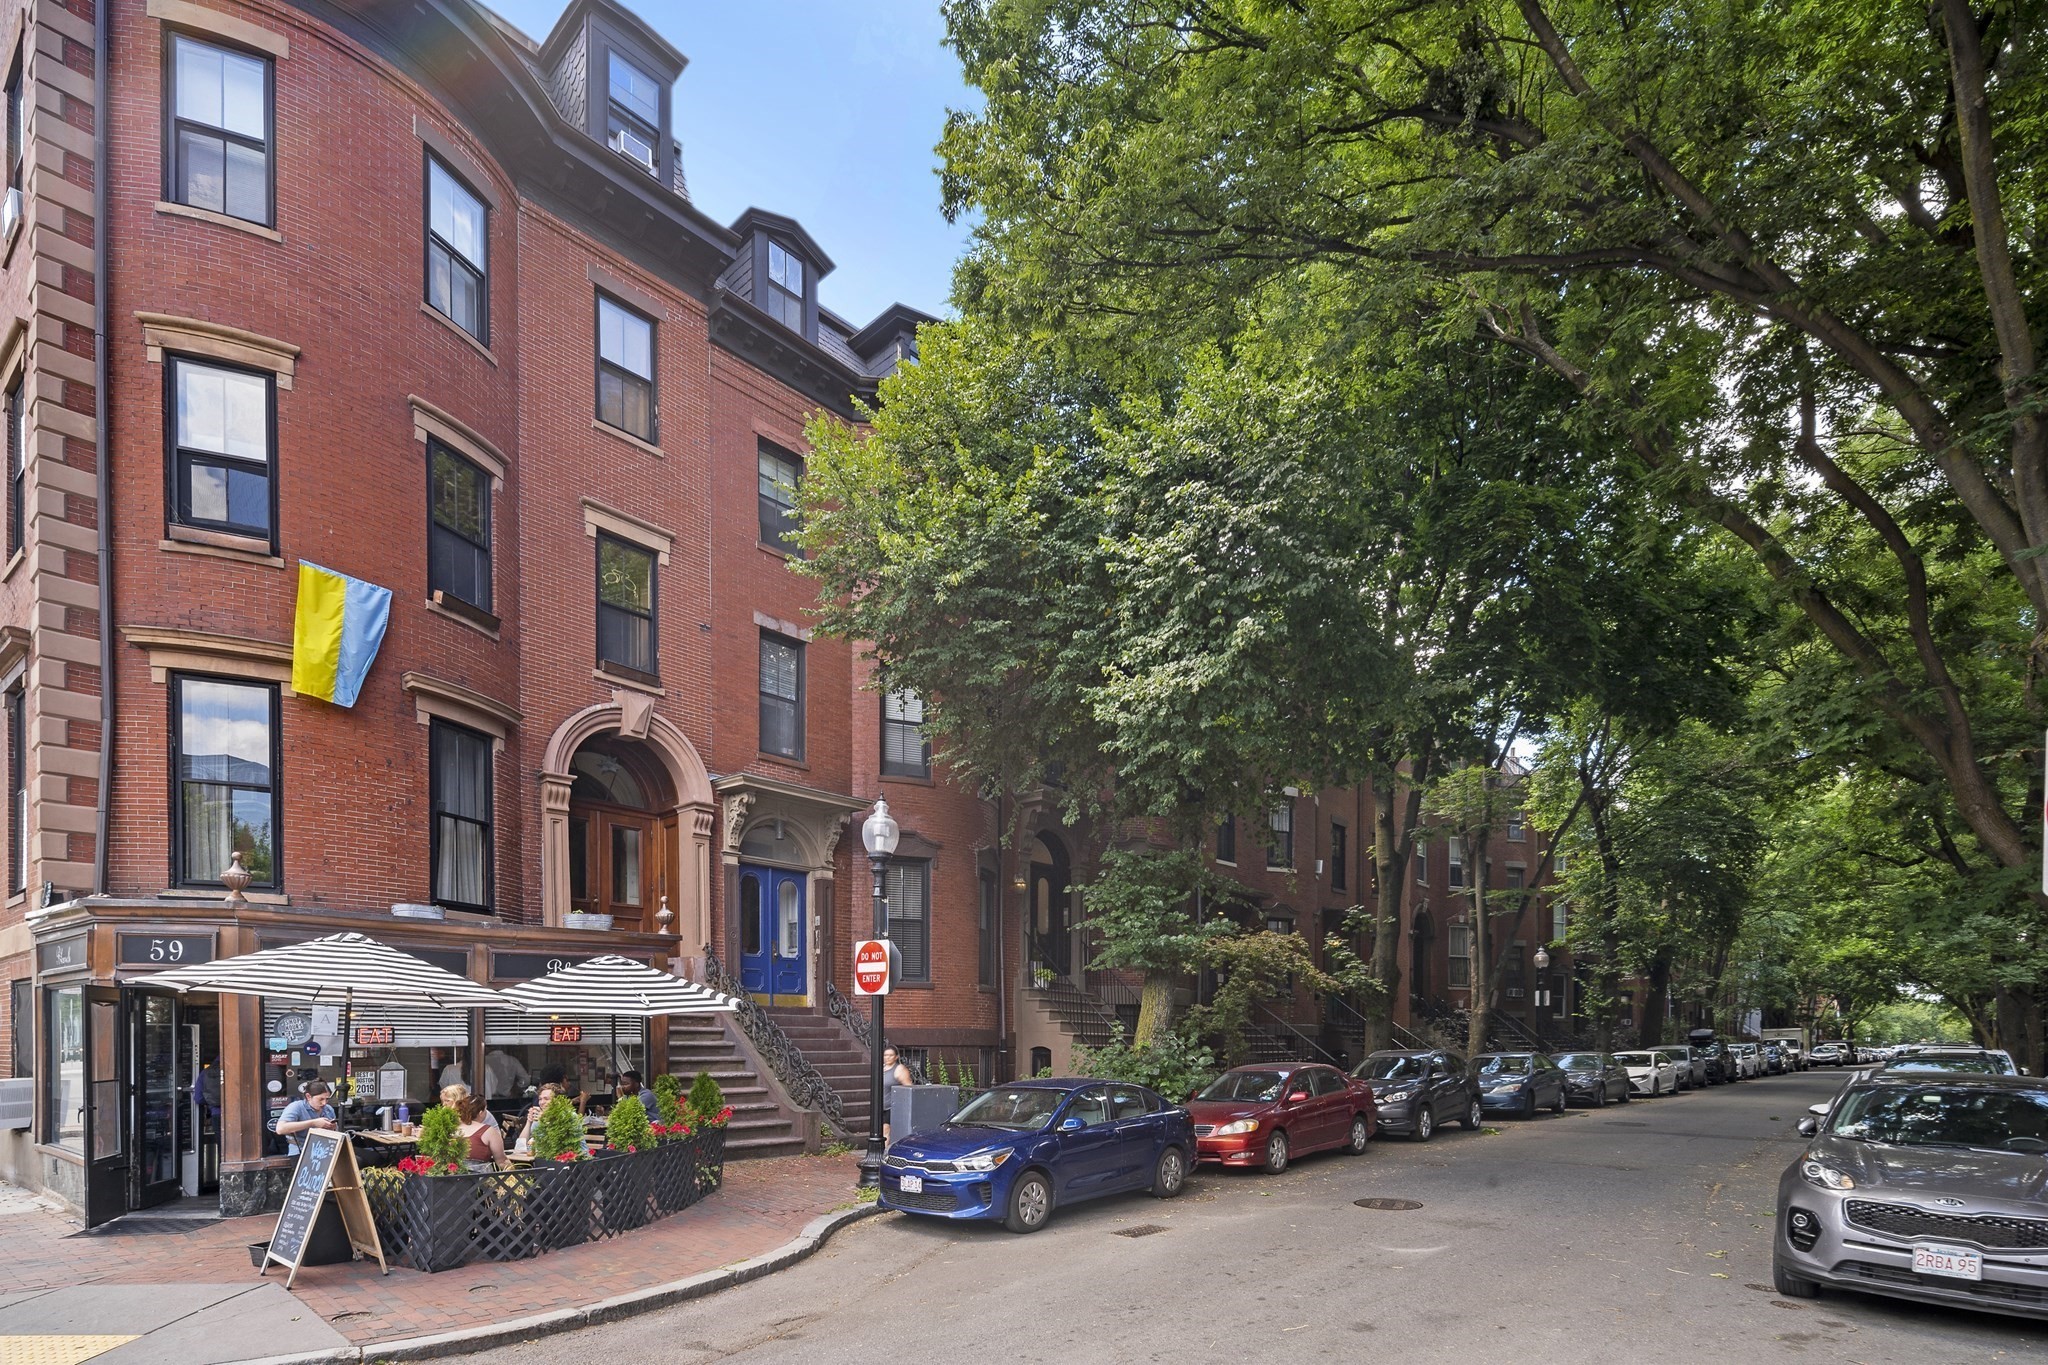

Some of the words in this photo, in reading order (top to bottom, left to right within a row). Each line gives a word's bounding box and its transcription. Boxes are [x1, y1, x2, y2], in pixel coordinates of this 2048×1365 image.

[149, 939, 184, 962] 59
[861, 952, 869, 960] DO
[871, 951, 883, 960] NOT
[862, 974, 881, 983] ENTER
[320, 1014, 331, 1024] A
[357, 1027, 392, 1044] EAT
[553, 1027, 580, 1042] EAT
[356, 1084, 375, 1094] 2019
[1916, 1253, 1953, 1270] 2RBA
[1958, 1258, 1977, 1273] 95
